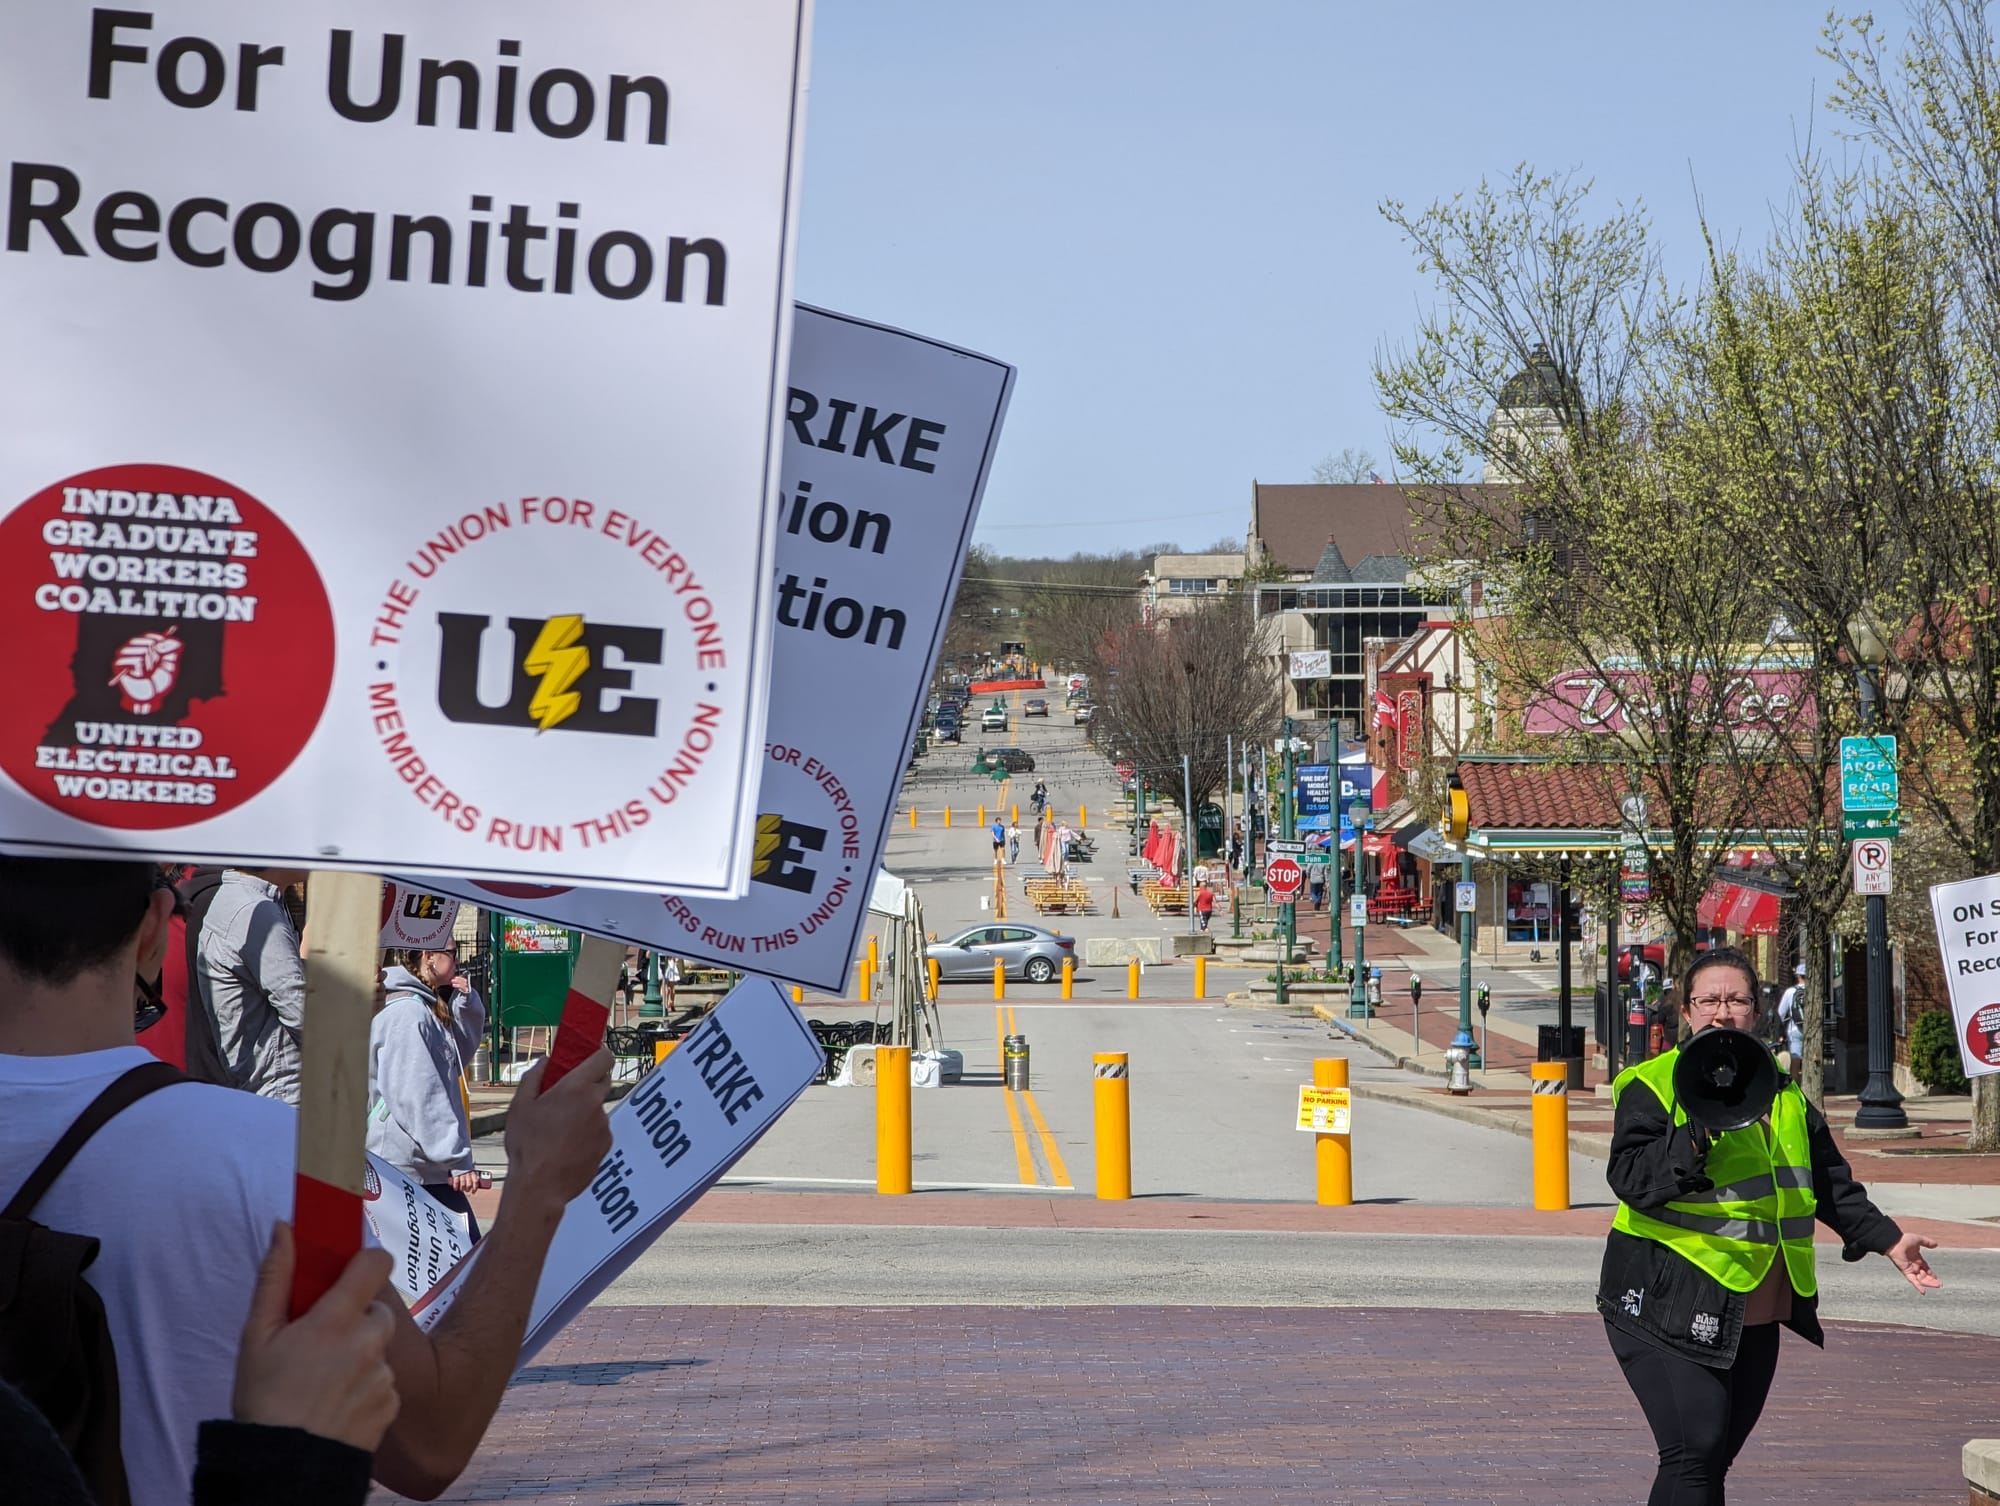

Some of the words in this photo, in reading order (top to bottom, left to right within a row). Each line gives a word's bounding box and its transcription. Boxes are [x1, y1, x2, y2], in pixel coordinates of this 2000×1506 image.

[86, 7, 283, 112] For
[328, 28, 670, 146] Union
[6, 160, 729, 306] Recognition
[62, 487, 242, 524] INDIANA
[42, 519, 258, 557] GRADUATE
[50, 552, 247, 589] WORKERS
[371, 580, 419, 647] THE
[407, 502, 511, 579] UNION
[520, 497, 595, 528] FOR
[602, 510, 727, 670] EVERYONE
[35, 584, 257, 621] COALITION
[774, 570, 907, 651] tion
[435, 611, 665, 737] UE
[75, 721, 202, 749] UNITED
[36, 746, 236, 778] ELECTRICAL
[368, 681, 482, 833] MEMBERS
[486, 818, 562, 852] RUN
[572, 800, 651, 848] THIS
[648, 703, 722, 805] UNION
[54, 775, 216, 805] WORKERS
[1849, 782, 1891, 793] ROAD
[802, 758, 860, 860] EVERYONE
[1304, 855, 1322, 863] Dunn
[1624, 859, 1647, 867] STOP
[1626, 849, 1645, 858] BUS
[1268, 868, 1300, 883] STOP
[1865, 873, 1881, 882] ANY
[1865, 882, 1883, 892] TIME
[700, 925, 745, 953] RUN
[751, 927, 799, 954] THIS
[799, 876, 853, 937] UNION
[1953, 902, 1984, 923] ON
[1965, 930, 1998, 947] For
[683, 1011, 765, 1127] TRIKE
[1316, 1097, 1348, 1105] PARKING
[423, 1202, 438, 1234] For
[440, 1210, 458, 1239] ON
[401, 1178, 420, 1293] Recognition
